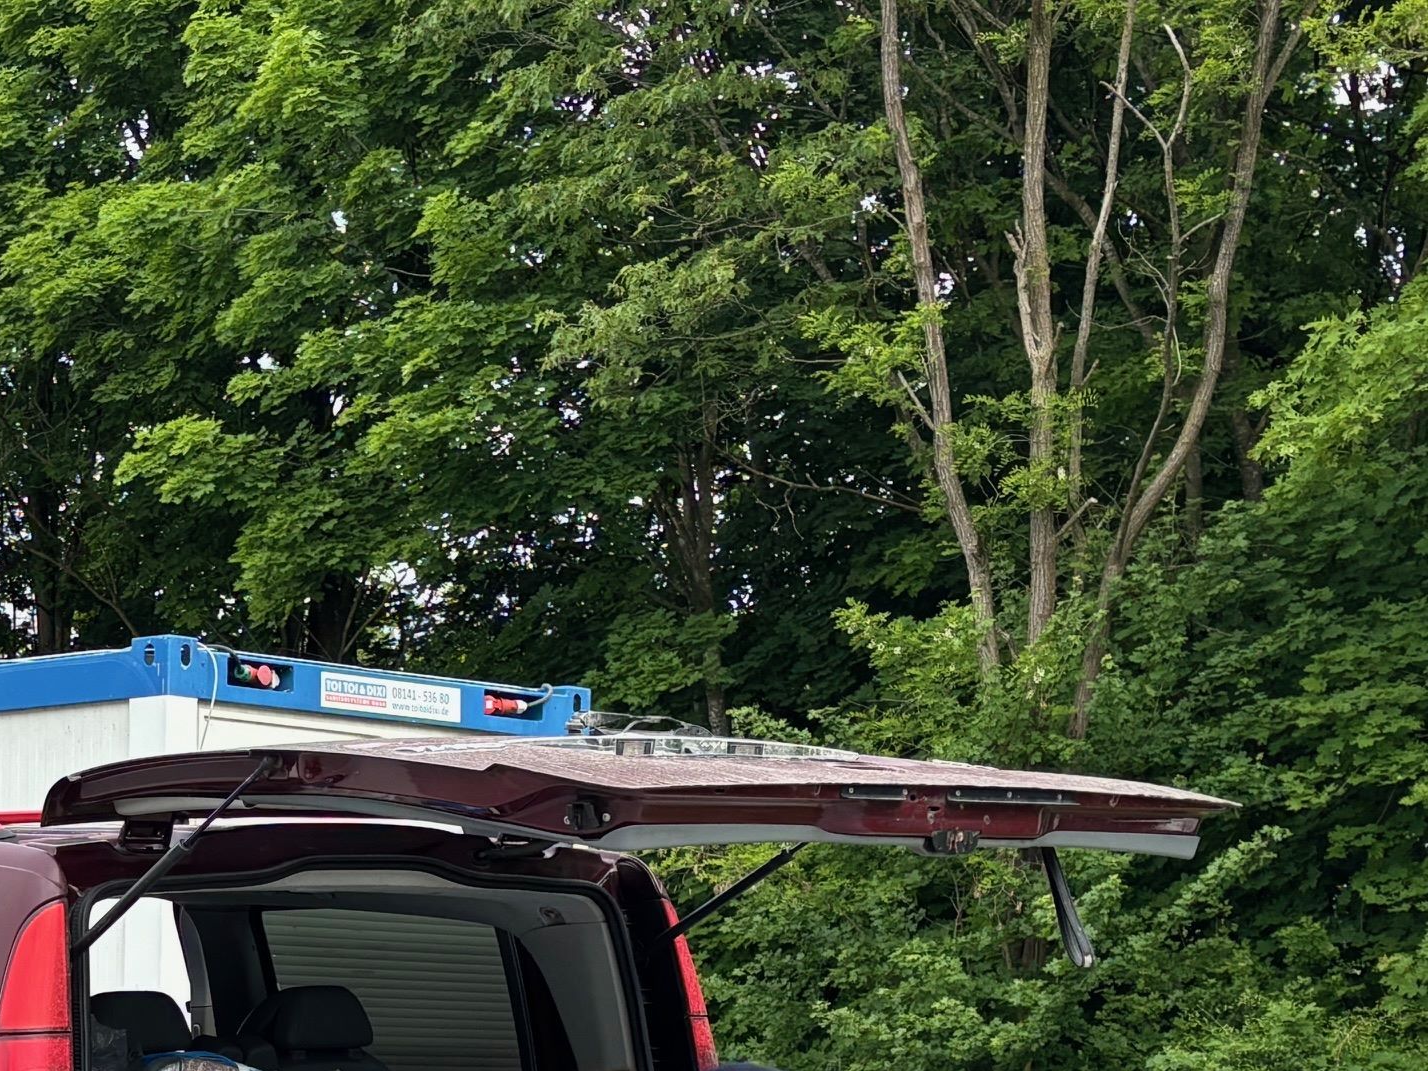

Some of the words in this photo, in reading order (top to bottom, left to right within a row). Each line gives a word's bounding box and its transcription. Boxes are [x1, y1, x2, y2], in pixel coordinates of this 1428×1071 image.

[326, 679, 342, 692] TOI
[344, 681, 359, 694] TOI
[366, 685, 386, 698] DIXI
[392, 687, 417, 701] 08141
[423, 690, 438, 704] 536
[439, 692, 450, 705] 80
